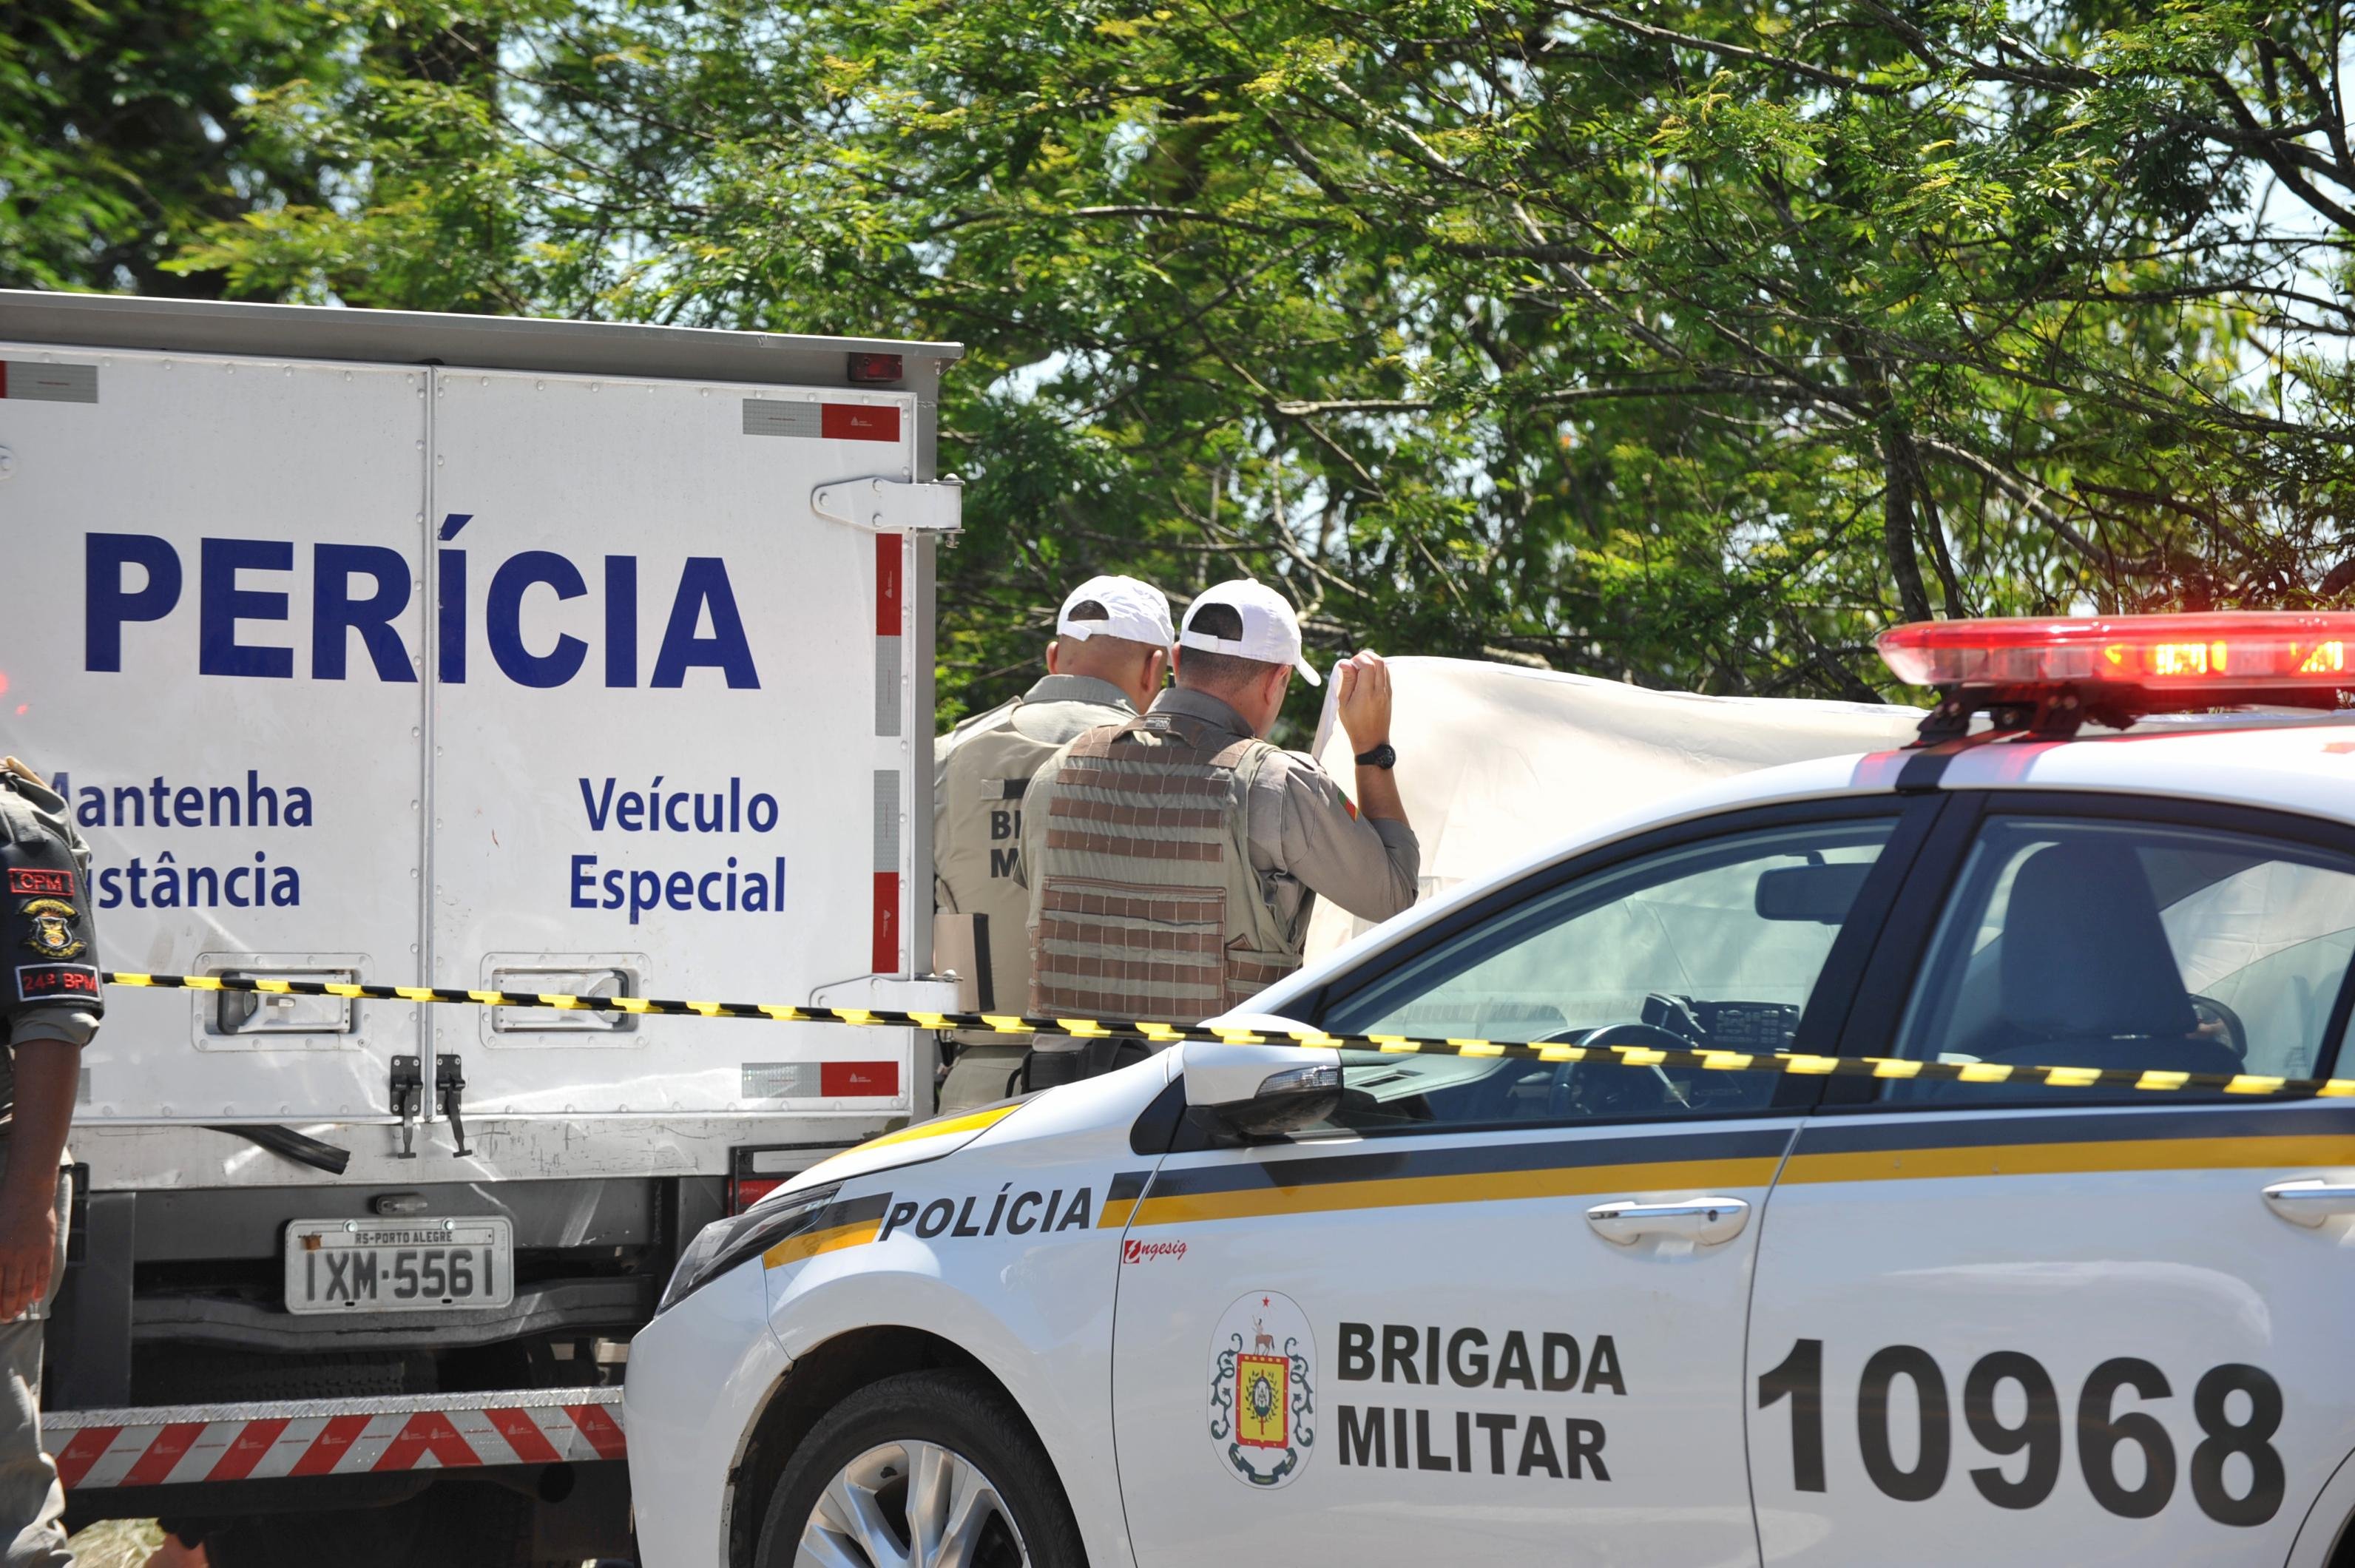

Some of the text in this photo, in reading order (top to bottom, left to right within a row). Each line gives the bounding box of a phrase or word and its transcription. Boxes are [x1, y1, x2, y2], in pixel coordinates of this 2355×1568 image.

[85, 513, 762, 689] PERÍCIA
[579, 777, 779, 834] Veículo
[19, 873, 63, 892] CPM
[87, 851, 300, 909] istância
[572, 855, 786, 925] Especial
[62, 972, 98, 993] BPM
[354, 1230, 453, 1245] RS-PORTO ALEGRE
[878, 1181, 1092, 1243] POLÍCIA
[1337, 1322, 1627, 1396] BRIGADA
[1337, 1404, 1612, 1482] MILITAR
[1756, 1337, 2286, 1529] 10968
